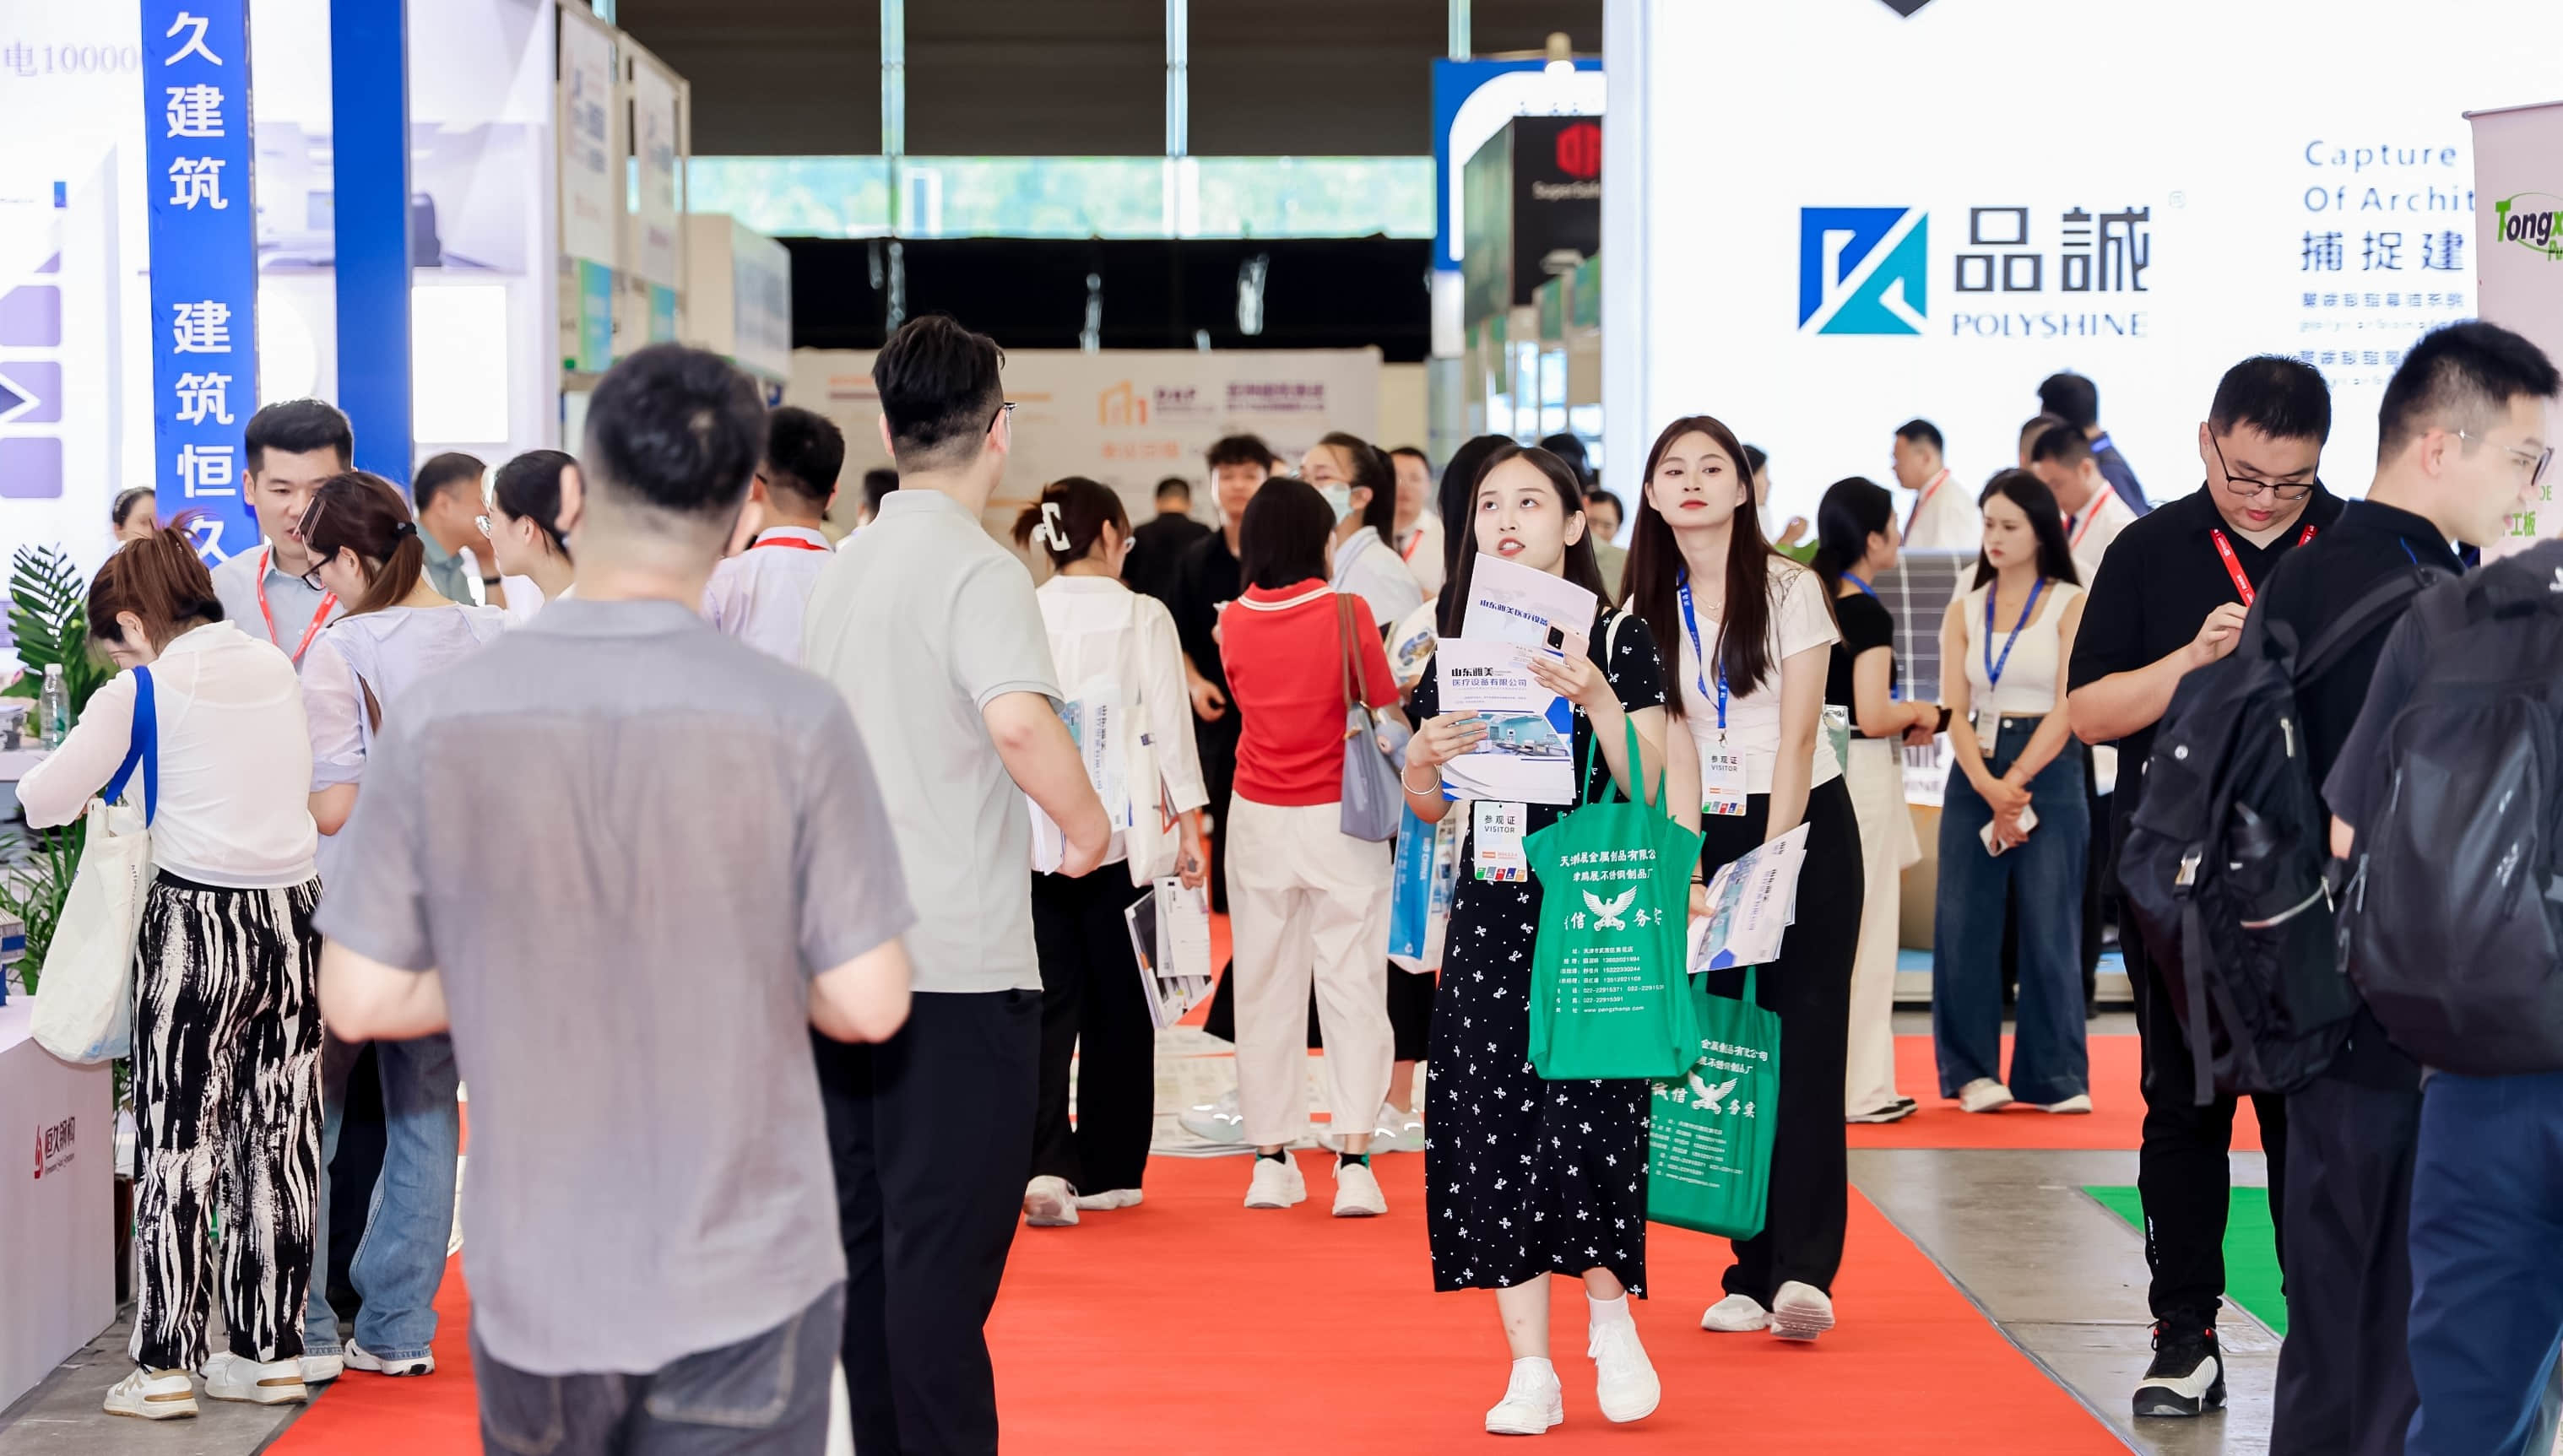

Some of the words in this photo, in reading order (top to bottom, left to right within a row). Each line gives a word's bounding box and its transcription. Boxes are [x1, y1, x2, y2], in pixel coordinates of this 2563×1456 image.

[5, 41, 142, 76] 电10000
[165, 12, 228, 210] 久建筑
[2306, 140, 2457, 172] Capture
[2305, 186, 2345, 212] Of
[2360, 185, 2475, 212] Archit
[1954, 207, 2149, 292] 品誠
[2301, 230, 2464, 271] 捕捉建
[1953, 312, 2148, 337] POLYSHINE
[172, 300, 236, 567] 建筑恒久
[2503, 511, 2536, 537] 工板
[1452, 679, 1527, 687] 医疗设备有限公司
[1711, 754, 1738, 764] 参观证
[1484, 815, 1515, 825] 参观证
[1563, 911, 1586, 931] 信
